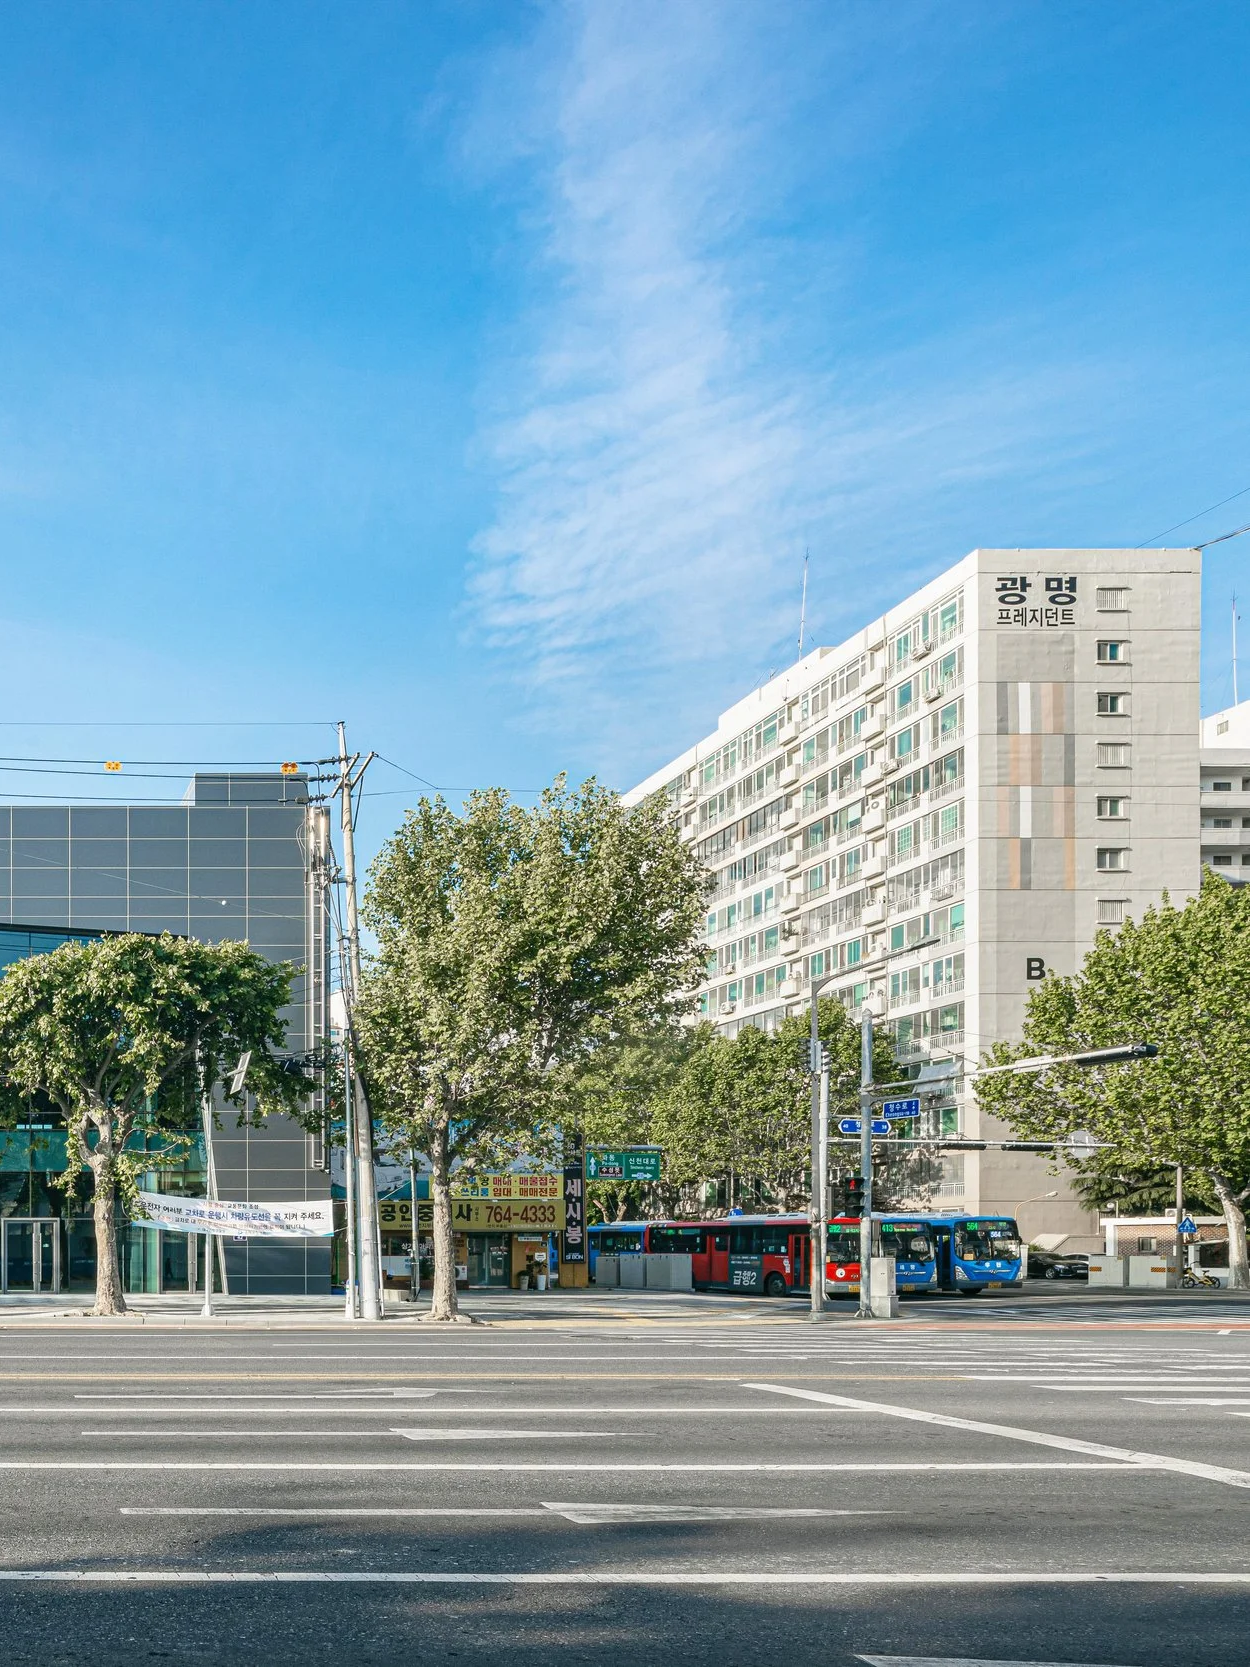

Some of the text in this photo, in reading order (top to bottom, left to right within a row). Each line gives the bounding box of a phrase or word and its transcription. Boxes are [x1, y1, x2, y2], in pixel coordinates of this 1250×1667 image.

[995, 576, 1078, 606] 광명
[996, 607, 1076, 628] 프레지던트
[1027, 958, 1046, 980] B
[888, 1102, 908, 1112] 청수로
[185, 1209, 206, 1218] 교차로
[284, 1212, 298, 1220] 지켜
[381, 1203, 473, 1222] 공인중사
[485, 1205, 556, 1223] 764-4333
[966, 1222, 978, 1231] 564
[733, 1270, 758, 1286] 급행2
